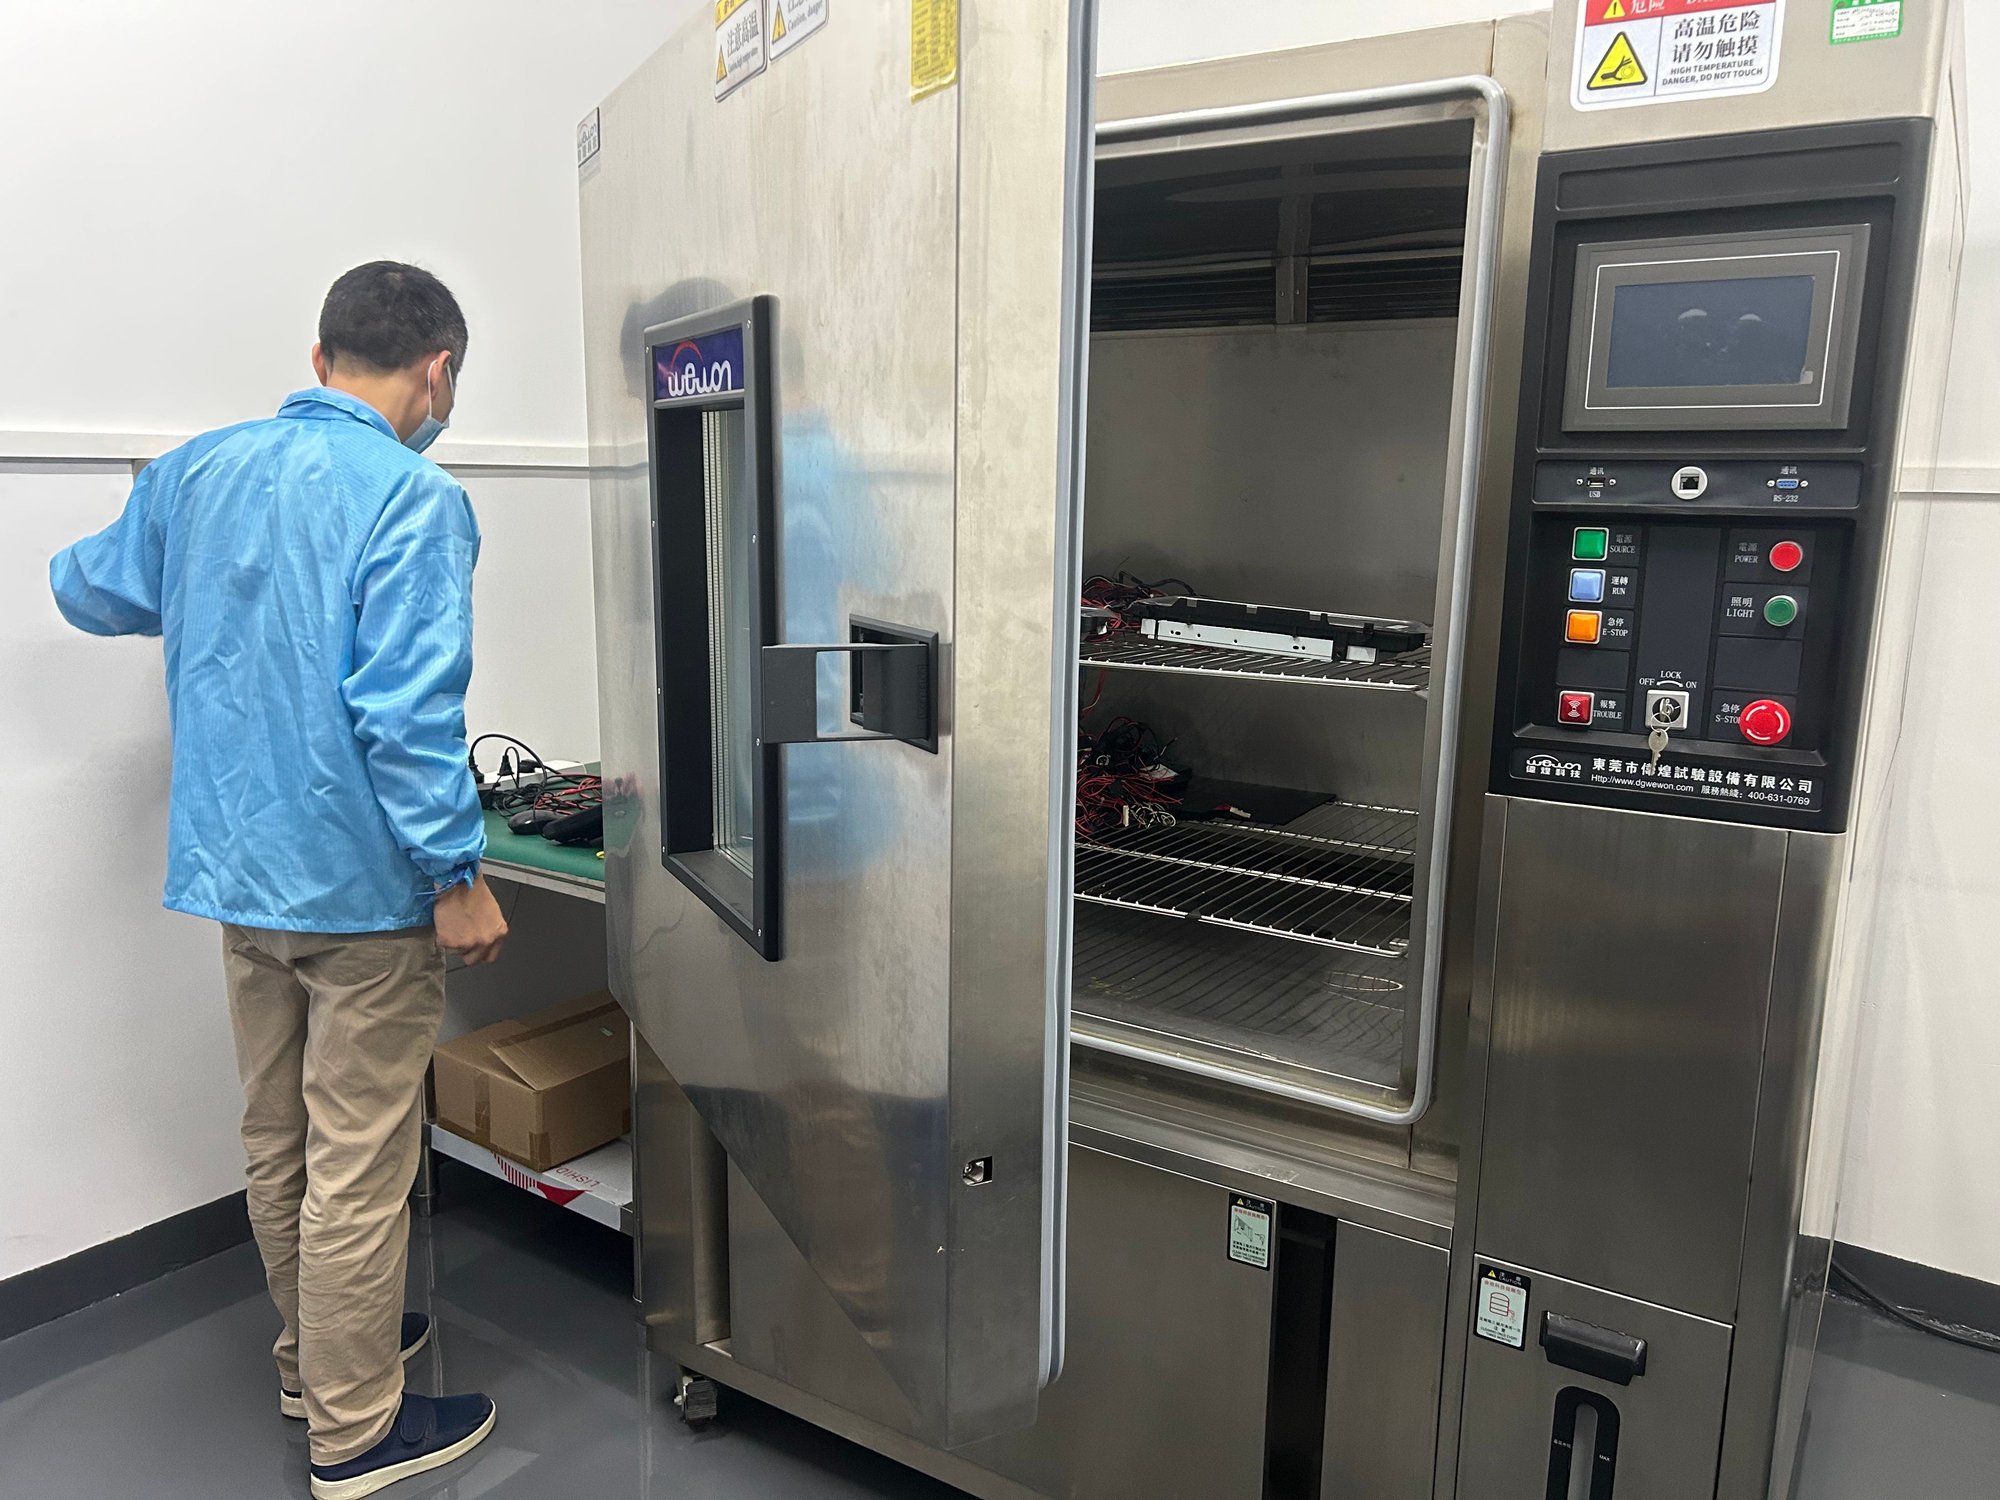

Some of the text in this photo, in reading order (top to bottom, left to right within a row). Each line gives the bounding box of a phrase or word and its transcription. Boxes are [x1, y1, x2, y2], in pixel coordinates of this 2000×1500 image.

[1674, 10, 1761, 39] 高温危险
[1673, 35, 1759, 63] 请勿触摸
[1670, 59, 1755, 75] HIGH TEMPERATURE
[1662, 67, 1763, 86] DANGER, DO NOT TOUCH
[1589, 490, 1601, 498] USB
[1773, 494, 1799, 502] RS-232
[1609, 545, 1636, 554] SOURCE
[1734, 554, 1759, 563] POWER
[1612, 587, 1626, 595] RUN
[1730, 596, 1753, 608] 照明
[1726, 608, 1755, 618] LIGHT
[1607, 617, 1625, 627] 急停
[1602, 628, 1628, 637] E-STOP
[1660, 670, 1682, 679] LOCK
[1639, 677, 1655, 686] OFF
[1685, 681, 1698, 689] ON
[1721, 703, 1740, 714] 急停
[1593, 710, 1622, 720] TROUBLE
[1715, 714, 1740, 724] S-STO
[1591, 774, 1694, 793] Http://www.dgwewon.com
[1747, 791, 1810, 806] 400-631-0769
